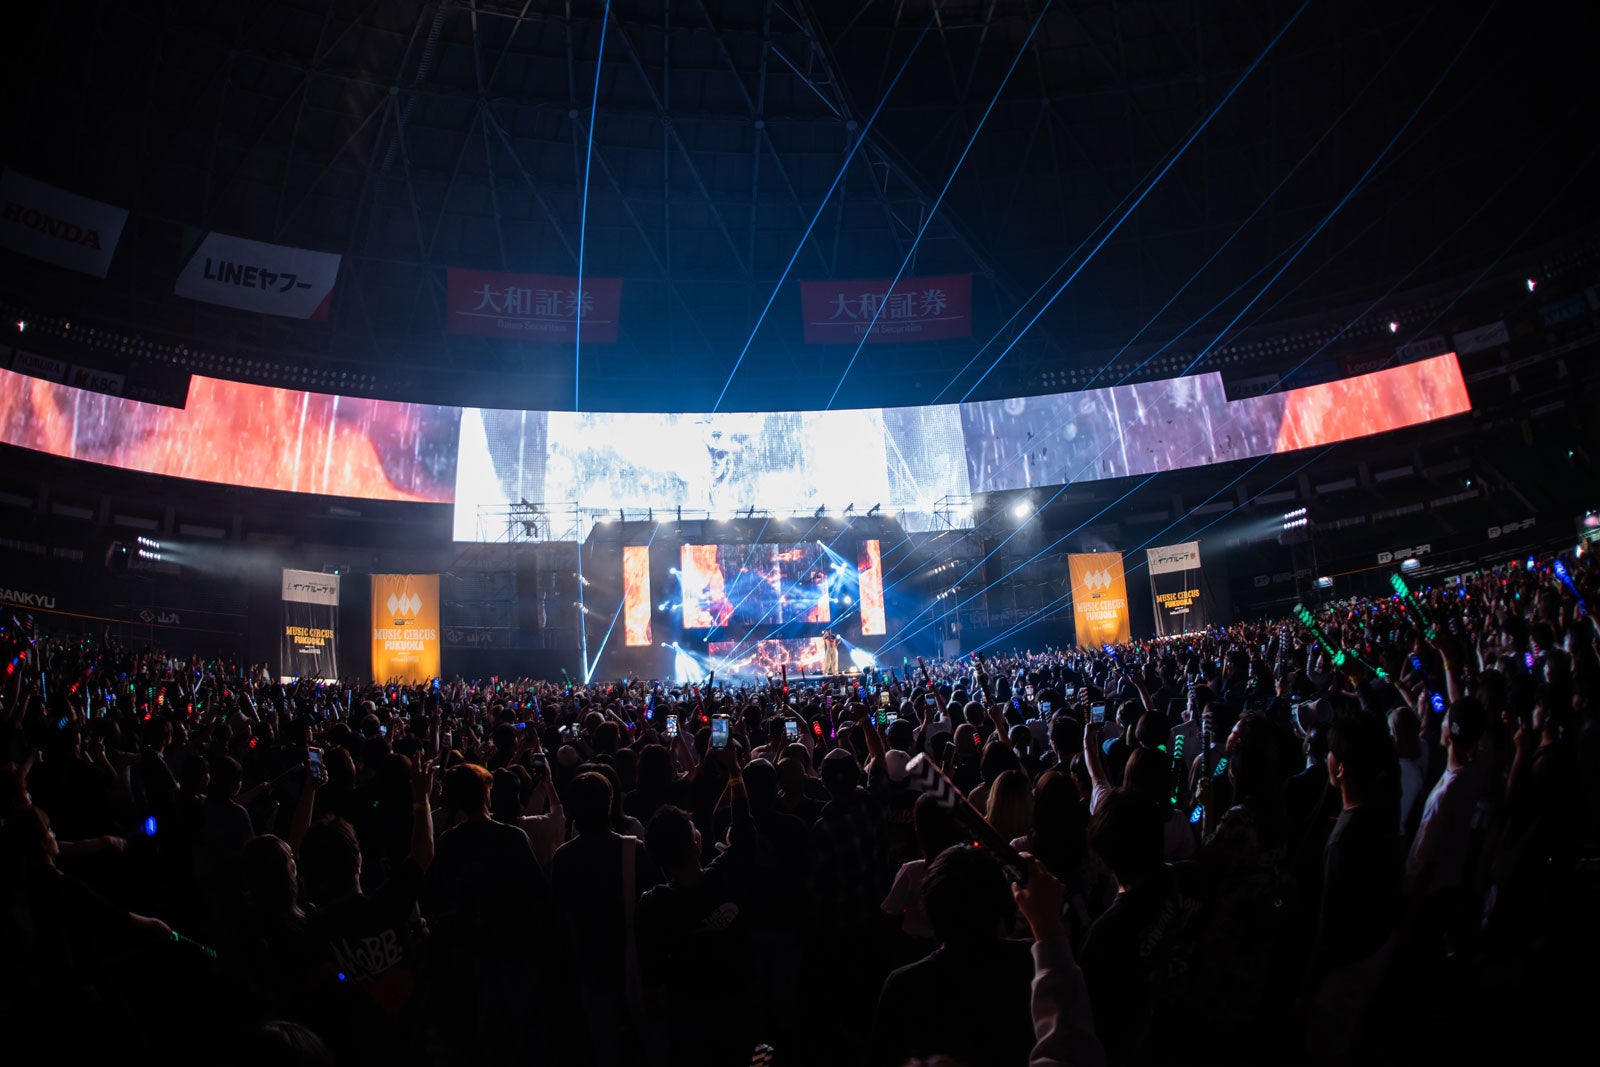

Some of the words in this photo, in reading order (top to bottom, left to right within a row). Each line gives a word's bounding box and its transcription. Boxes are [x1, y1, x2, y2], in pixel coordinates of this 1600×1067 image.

[3, 201, 101, 250] HONDA
[204, 258, 312, 293] LINEヤフー
[473, 283, 594, 318] 大和証券
[829, 288, 948, 320] 大和証券
[17, 353, 61, 374] NOMURA
[91, 375, 119, 392] KBC
[0, 587, 55, 609] SANKYU
[286, 626, 308, 636] MUSIC
[309, 627, 334, 638] CIRCUS
[375, 628, 402, 640] MUSIC
[403, 628, 436, 641] CIRCUS
[384, 640, 424, 651] FUKUOKA
